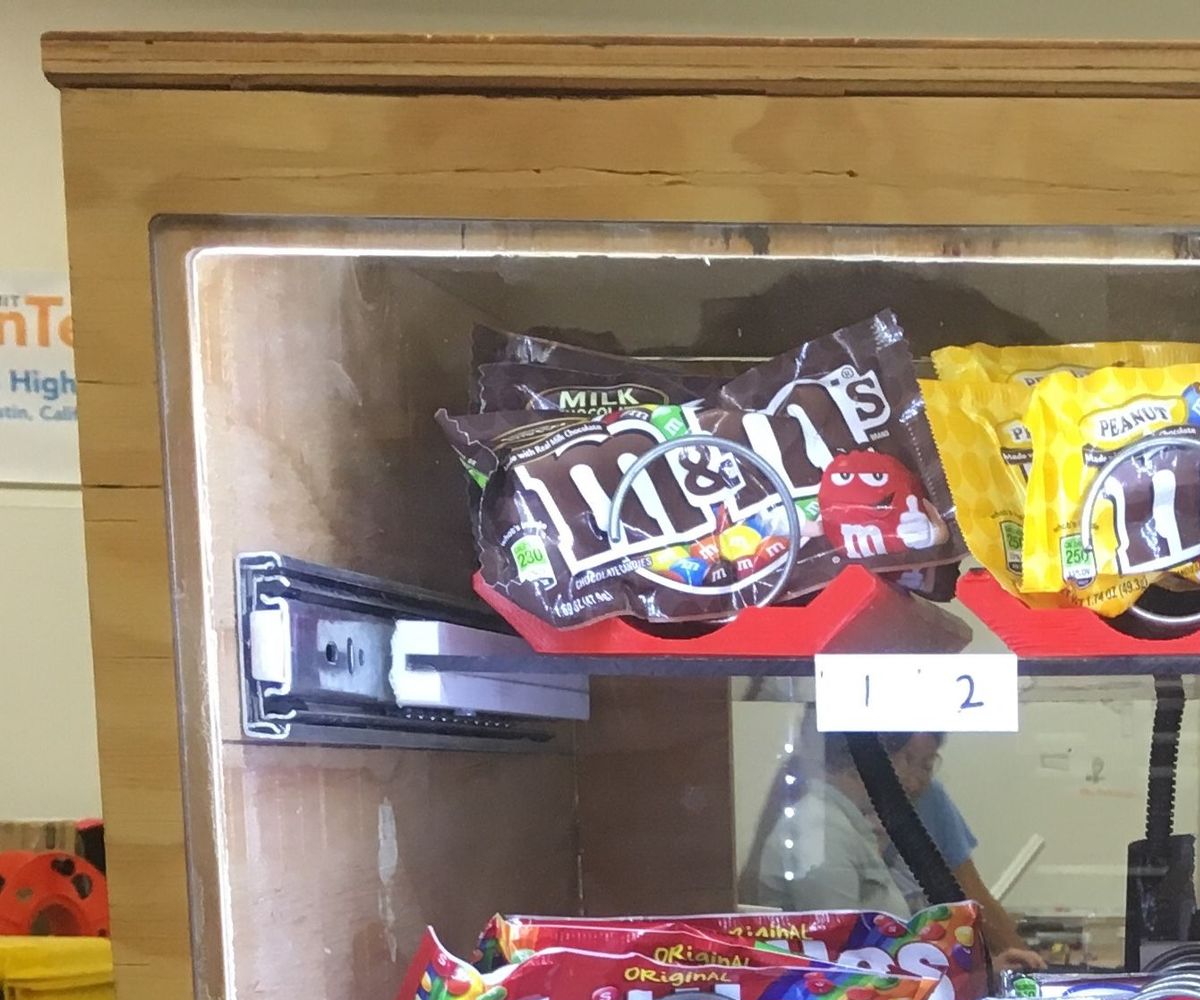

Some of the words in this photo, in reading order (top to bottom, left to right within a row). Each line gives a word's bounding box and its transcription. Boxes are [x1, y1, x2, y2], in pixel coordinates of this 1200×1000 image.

[9, 369, 77, 401] High
[559, 388, 639, 409] MILK
[1100, 405, 1169, 437] PEANUT
[840, 523, 888, 559] m
[516, 548, 544, 569] 230
[1065, 549, 1090, 564] 250
[575, 568, 621, 590] CHOCOLATE
[864, 674, 870, 707] 1
[956, 674, 984, 709] 2
